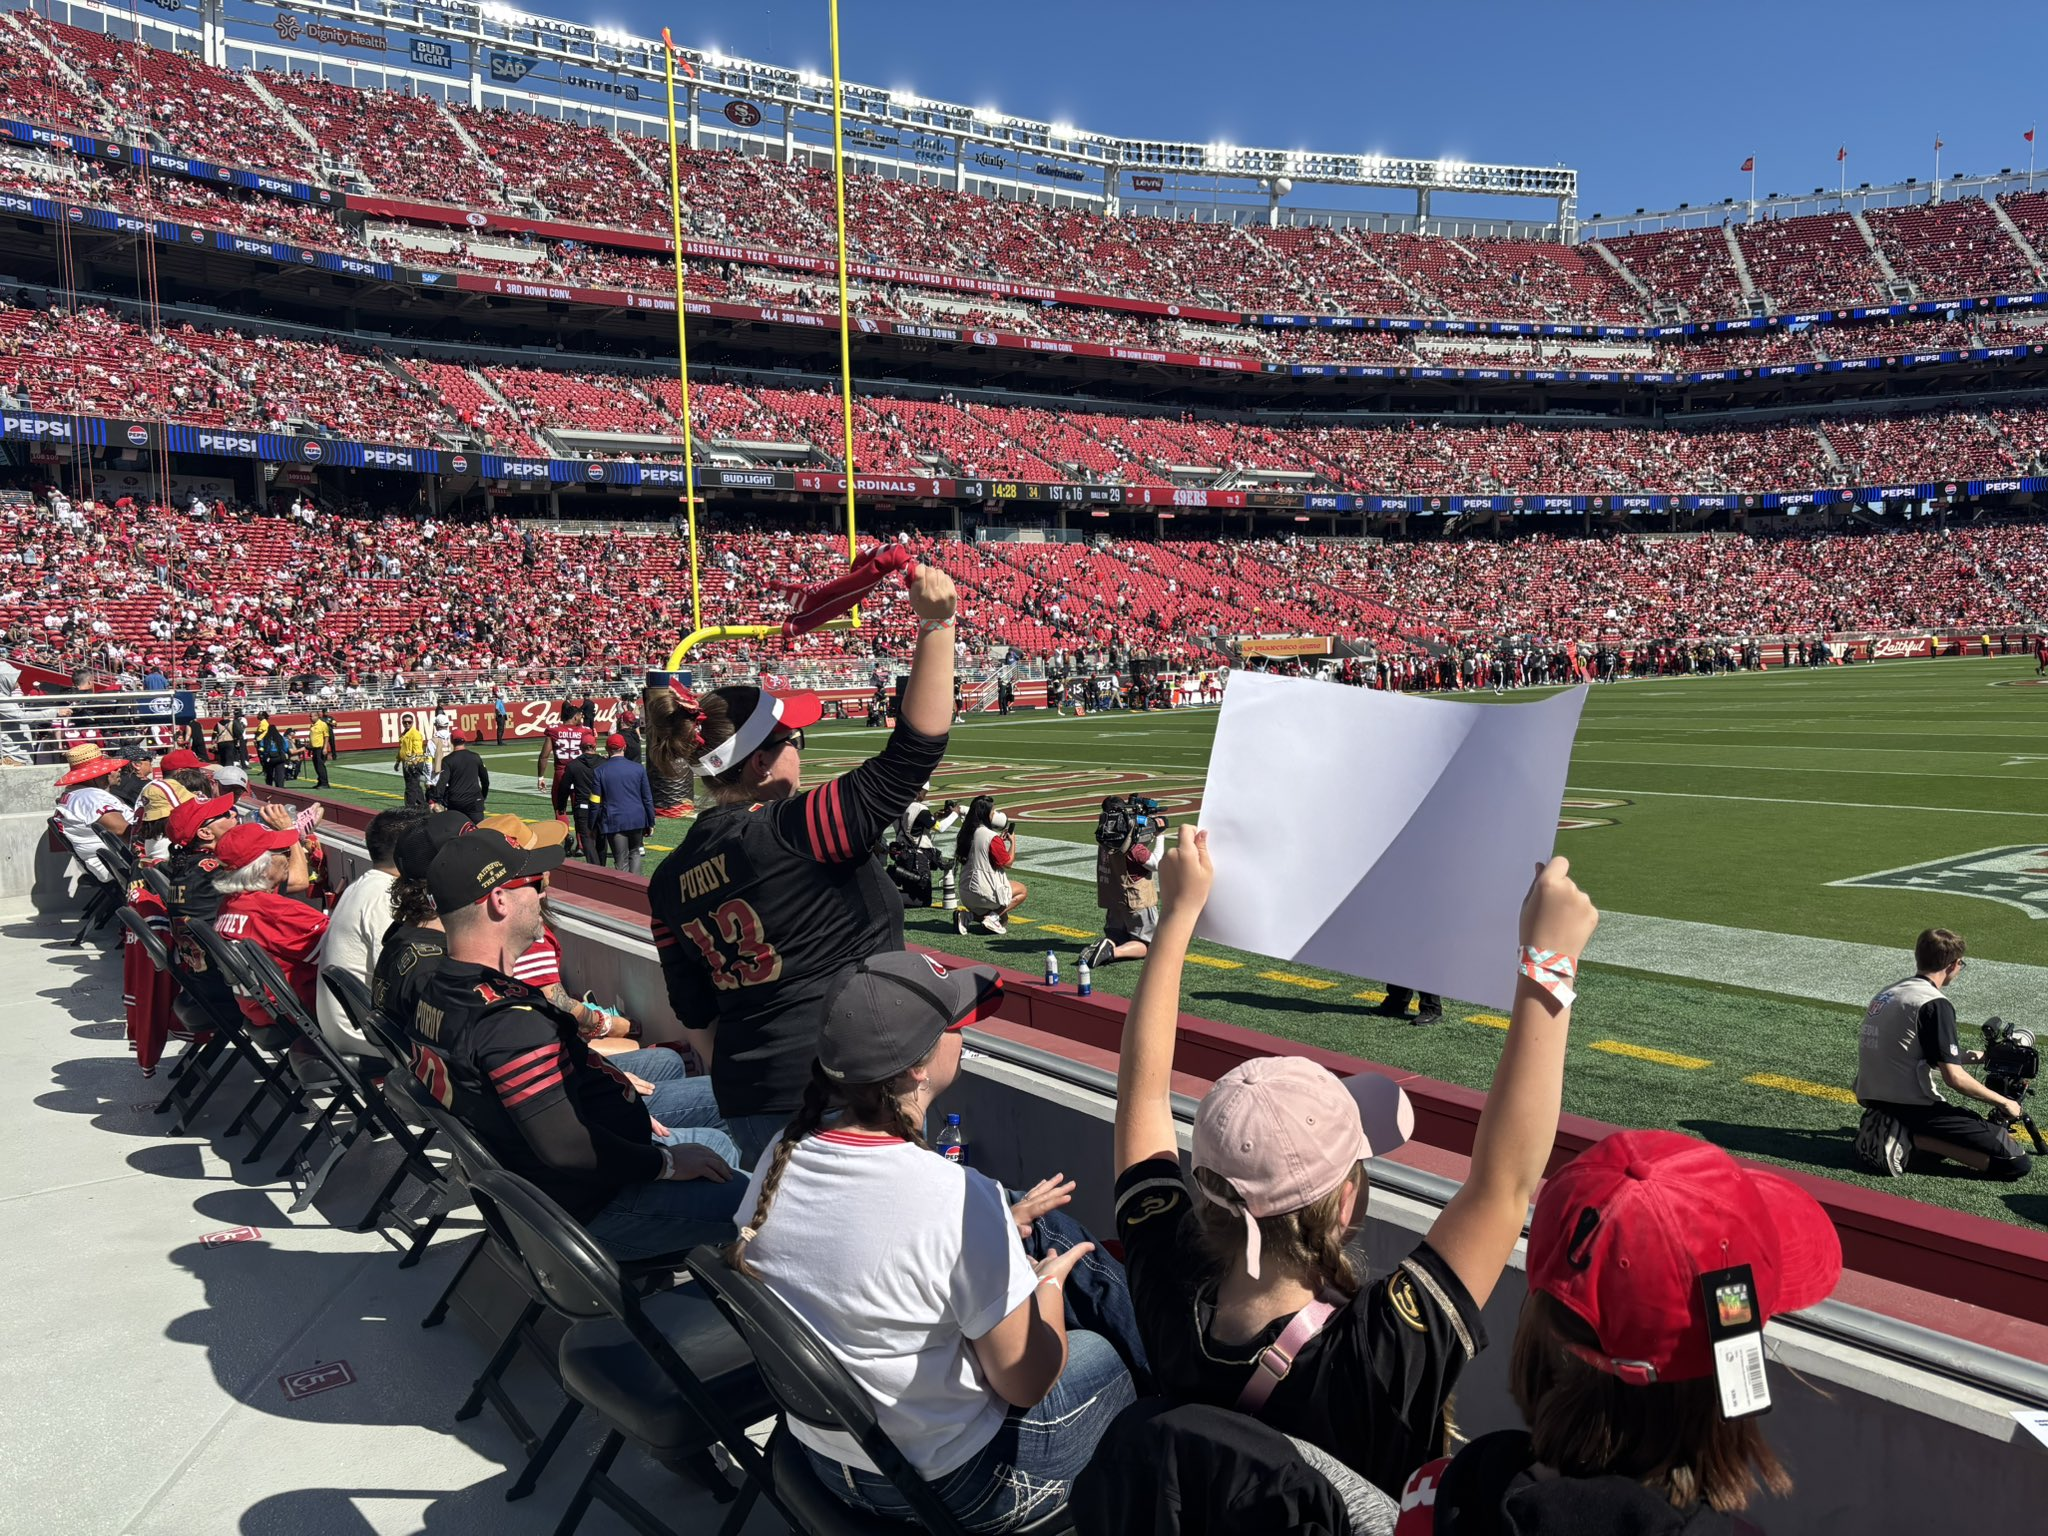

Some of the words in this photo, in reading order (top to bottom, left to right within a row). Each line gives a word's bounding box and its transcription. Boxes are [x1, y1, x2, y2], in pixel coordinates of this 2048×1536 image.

[308, 25, 348, 45] Dignity
[350, 35, 387, 49] Health
[417, 42, 445, 56] BUD
[412, 52, 450, 67] LIGHT
[491, 58, 528, 78] SAP
[567, 76, 622, 95] UNITED
[152, 155, 189, 171] PEPSI
[915, 151, 944, 163] cisco
[975, 152, 1006, 169] xfinity
[1036, 164, 1085, 181] ticketmaster
[258, 178, 292, 193] PEPSI
[117, 218, 158, 234] PEPSI
[235, 240, 272, 255] PEPSI
[342, 260, 375, 275] PEPSI
[687, 243, 743, 258] ASSISTANCE
[747, 251, 770, 262] TEXT
[824, 261, 835, 270] TO
[900, 271, 940, 283] FOLLOWED
[943, 276, 953, 286] BY
[956, 277, 975, 288] YOUR
[978, 281, 1011, 293] CONCERN
[1021, 286, 1056, 299] LOCATION
[495, 281, 502, 292] 4
[506, 283, 522, 294] 3RD
[524, 285, 548, 297] DOWN
[550, 288, 572, 299] CONV.
[638, 297, 652, 308] 3RD
[654, 299, 675, 310] DOWN
[1935, 301, 1961, 310] PEPSI
[2008, 295, 2033, 304] PEPSI
[1865, 308, 1890, 316] PEPSI
[782, 313, 795, 323] 3RD
[796, 315, 816, 325] DOWN
[1273, 316, 1294, 324] PEPSI
[1332, 318, 1352, 326] PEPSI
[1389, 320, 1410, 328] PEPSI
[1795, 314, 1820, 323] PEPSI
[1445, 322, 1465, 330] PEPSI
[1553, 326, 1572, 334] PEPSI
[1659, 327, 1683, 336] PEPSI
[1727, 321, 1751, 330] PEPSI
[897, 325, 915, 336] TEAM
[917, 327, 931, 338] 3RD
[932, 328, 957, 340] DOWNS
[1915, 354, 1940, 363] PEPSI
[1988, 349, 2014, 357] PEPSI
[1842, 360, 1867, 368] PEPSI
[1302, 367, 1323, 375] PEPSI
[1362, 368, 1384, 376] PEPSI
[1422, 369, 1442, 377] PEPSI
[1535, 372, 1555, 380] PEPSI
[1701, 372, 1725, 381] PEPSI
[1771, 366, 1795, 375] PEPSI
[1643, 374, 1662, 382] PEPSI
[4, 417, 71, 437] PEPSI
[199, 434, 257, 453] PEPSI
[363, 449, 412, 467] PEPSI
[503, 462, 549, 477] PEPSI
[640, 469, 684, 482] PEPSI
[723, 473, 746, 484] BUD
[746, 475, 772, 485] LIGHT
[814, 477, 821, 490] 3
[932, 480, 940, 495] 3
[976, 482, 983, 497] 3
[992, 483, 1017, 498] 14:28
[1029, 486, 1038, 498] 34
[1049, 486, 1063, 500] 1ST
[1065, 490, 1071, 500] &
[1072, 487, 1083, 500] 16
[1110, 488, 1121, 501] 29
[1985, 481, 2021, 492] PEPSI
[1144, 490, 1150, 503] 6
[1173, 489, 1208, 506] 49ERS
[1881, 488, 1915, 498] PEPSI
[1311, 497, 1336, 507] PEPSI
[1381, 500, 1407, 509] PEPSI
[1463, 499, 1492, 508] PEPSI
[1545, 499, 1571, 508] PEPSI
[1623, 498, 1649, 507] PEPSI
[1699, 498, 1724, 506] PEPSI
[1780, 495, 1814, 505] PEPSI
[1874, 638, 1926, 656] Faithful
[460, 714, 480, 732] OF
[484, 712, 514, 730] TE
[558, 731, 582, 739] COLLINS
[555, 739, 583, 760] 25
[481, 877, 496, 889] THE
[496, 867, 507, 880] BAY
[679, 853, 733, 904] PURDY
[681, 898, 784, 991] 13
[415, 999, 446, 1043] PURDY
[945, 1153, 964, 1161] PEPSI
